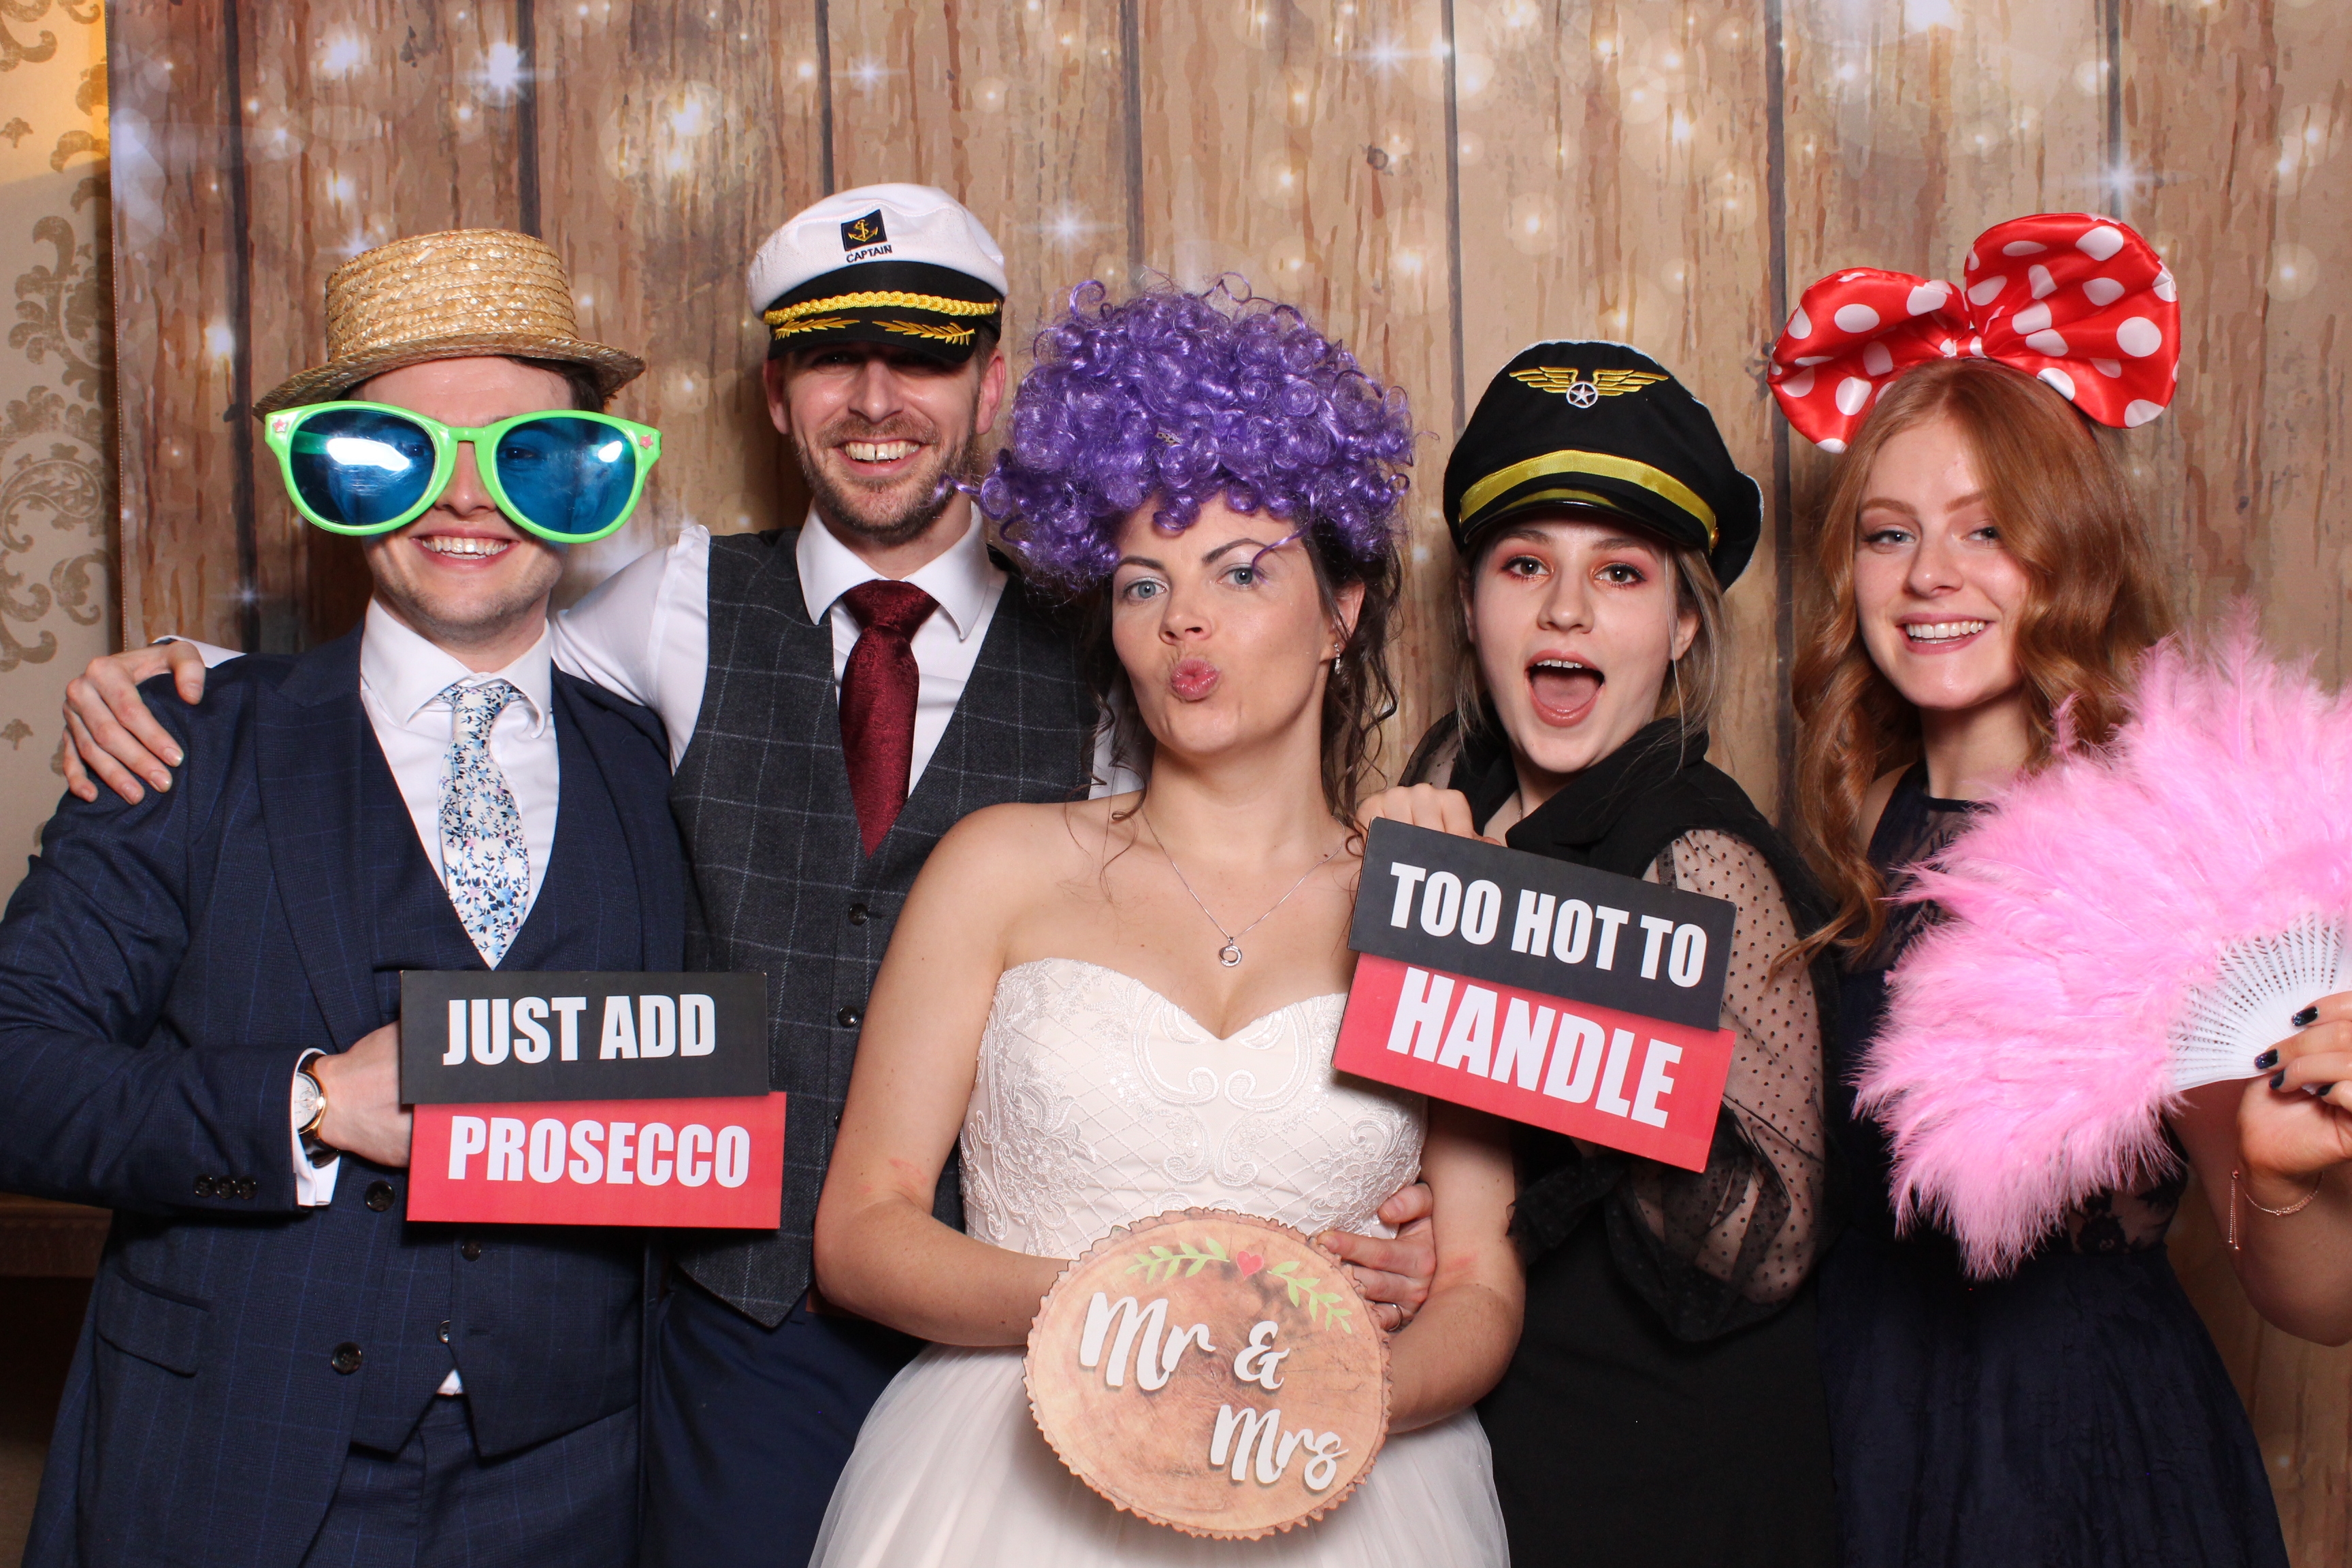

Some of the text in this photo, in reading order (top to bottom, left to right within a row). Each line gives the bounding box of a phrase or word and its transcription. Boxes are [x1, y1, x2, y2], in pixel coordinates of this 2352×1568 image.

[846, 244, 892, 263] CAPTAIN
[1390, 862, 1708, 988] TOO HOT TO
[442, 994, 716, 1066] JUST ADD
[1386, 966, 1683, 1129] HANDLE
[448, 1115, 750, 1188] PROSECCO
[1079, 1292, 1290, 1390] Mr &
[1210, 1405, 1350, 1490] Mrs
